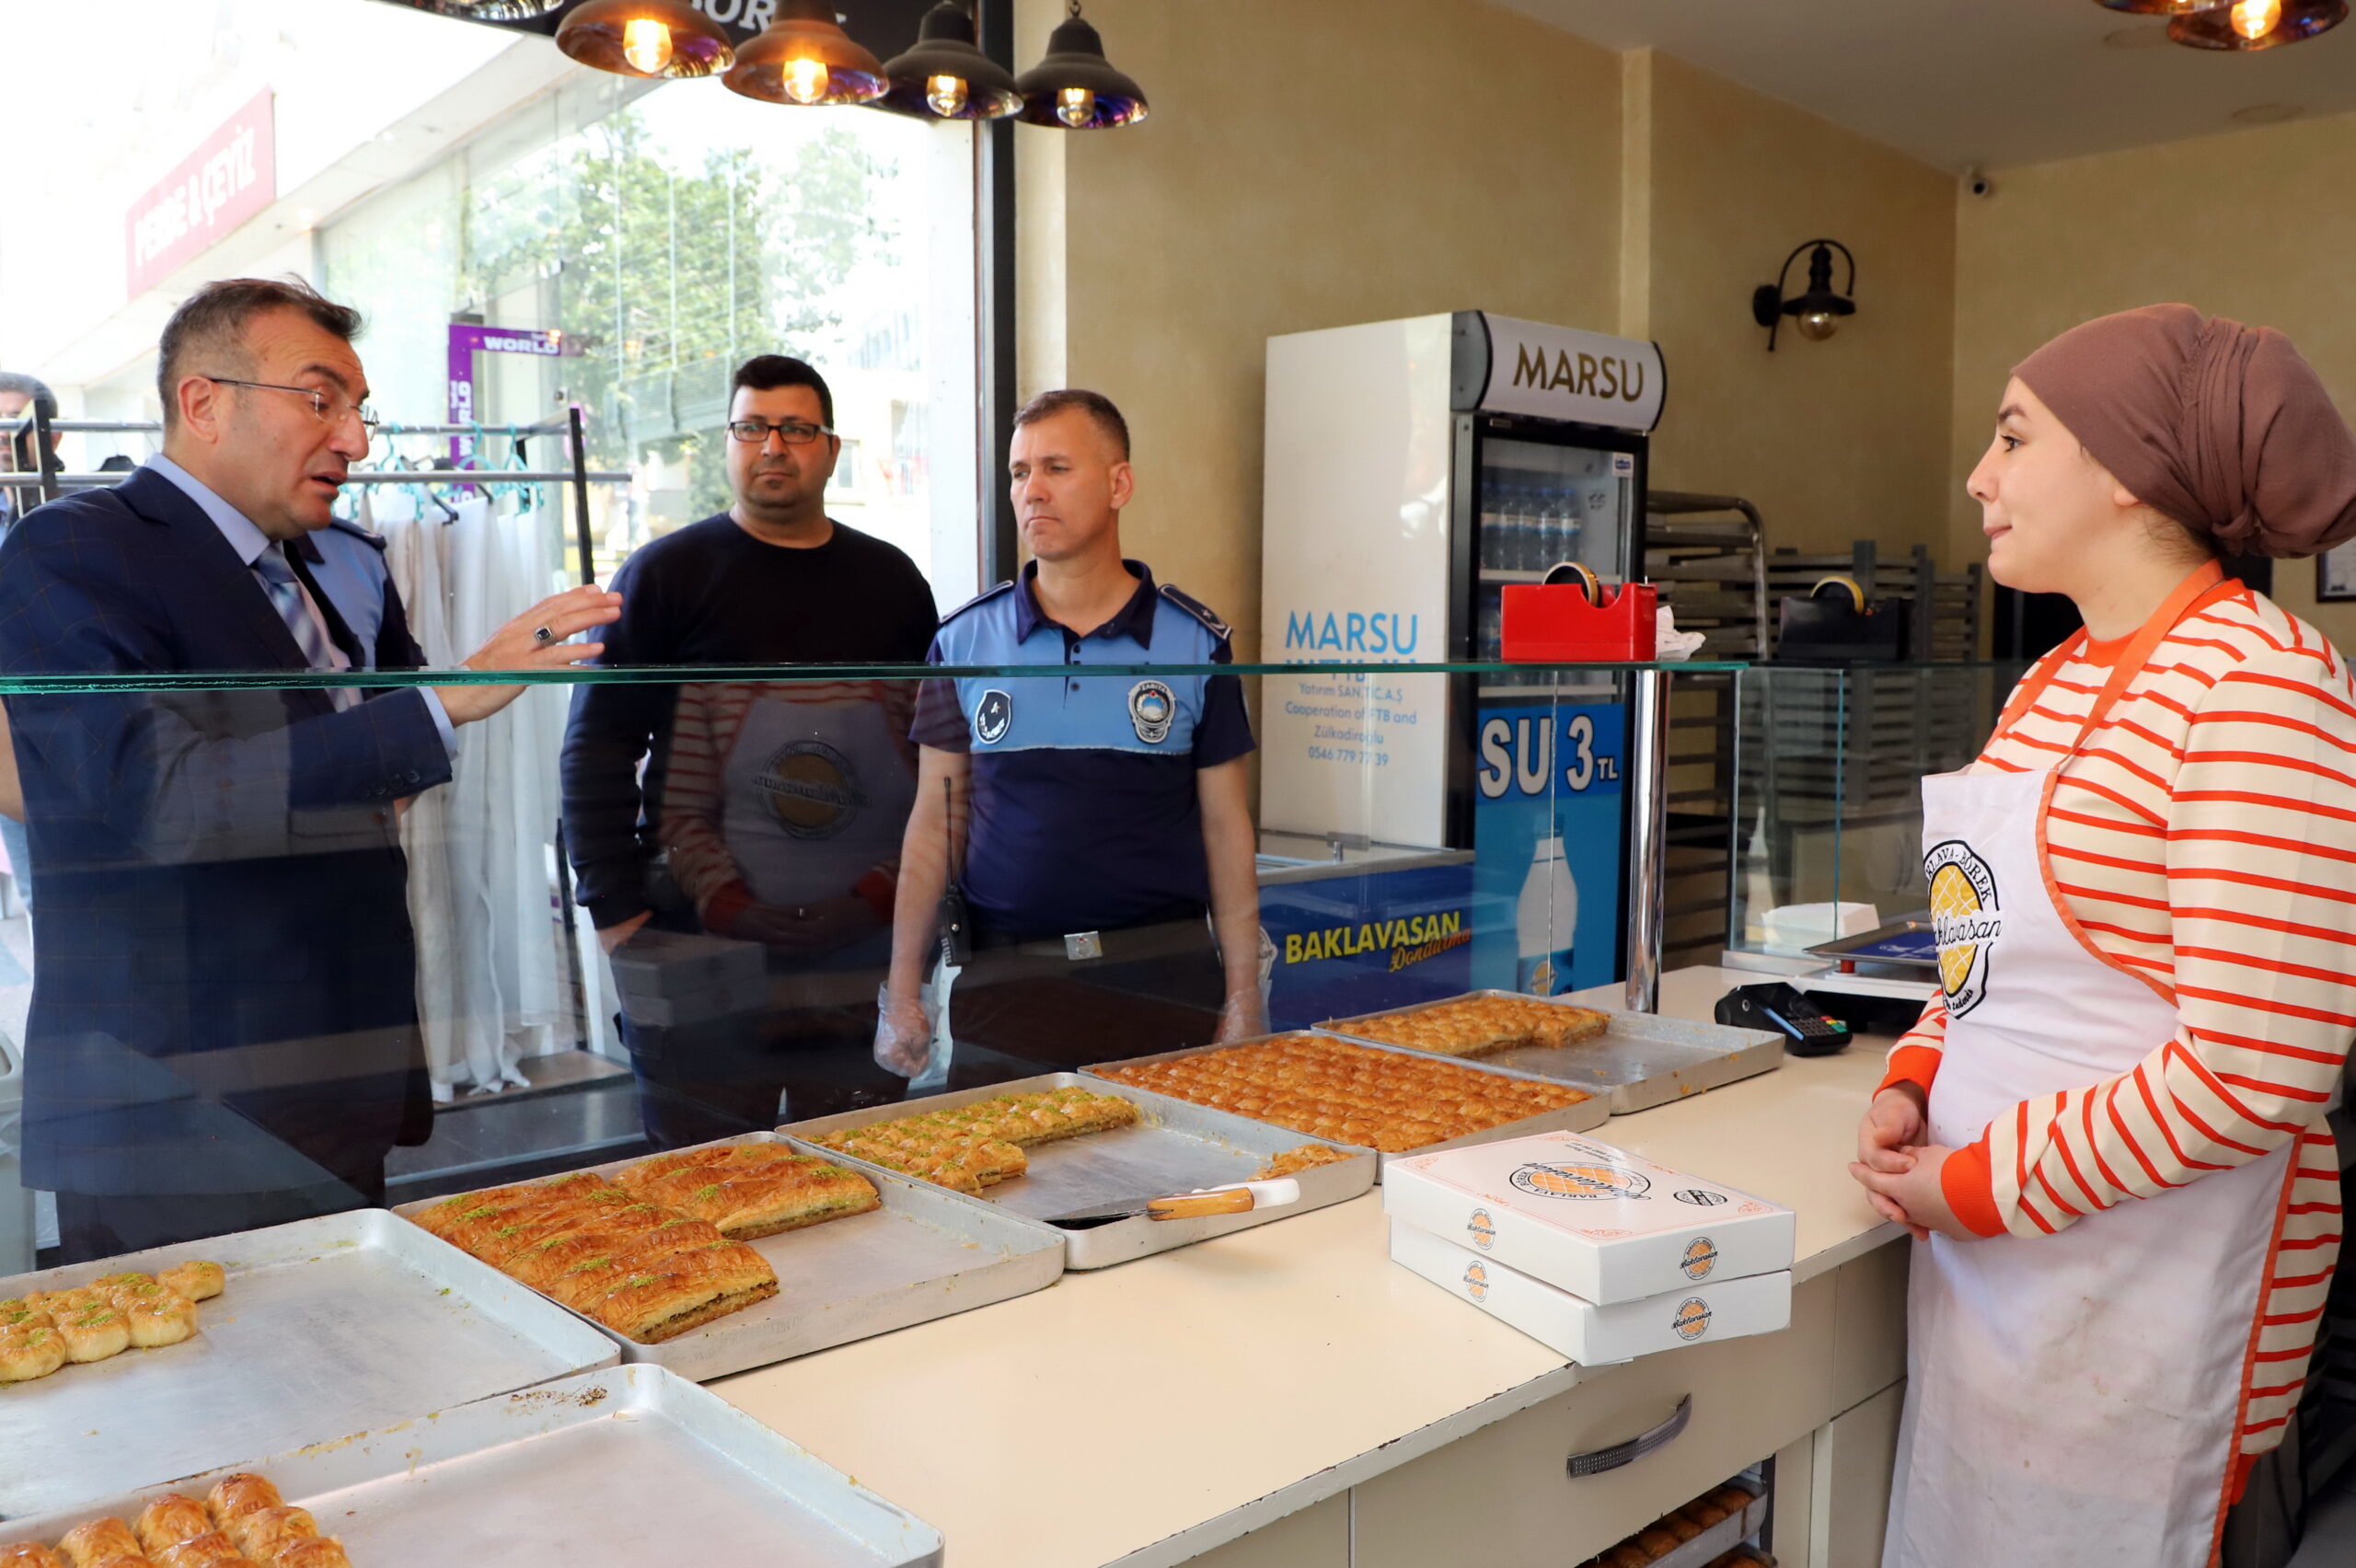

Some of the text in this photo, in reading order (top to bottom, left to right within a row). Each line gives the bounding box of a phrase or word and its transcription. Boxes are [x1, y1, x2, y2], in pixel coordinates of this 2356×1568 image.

[202, 124, 257, 227] ÇEYİZ
[483, 336, 560, 355] WORLD
[1512, 341, 1645, 403] MARSU
[458, 380, 473, 457] WRLD
[1285, 610, 1418, 655] MARSU
[1285, 700, 1352, 719] Cooperation
[1393, 709, 1417, 725] and
[1308, 745, 1334, 761] 0546
[1337, 748, 1357, 764] 779
[1375, 753, 1389, 767] 39
[1478, 713, 1619, 800] SU 3 TL
[1925, 847, 1954, 881] KLAVA
[1285, 910, 1461, 965] BAKLAVASAN
[1388, 927, 1472, 973] Dondurma
[1680, 1251, 1719, 1269] Baklavasan
[1671, 1310, 1713, 1331] Baklavasan
